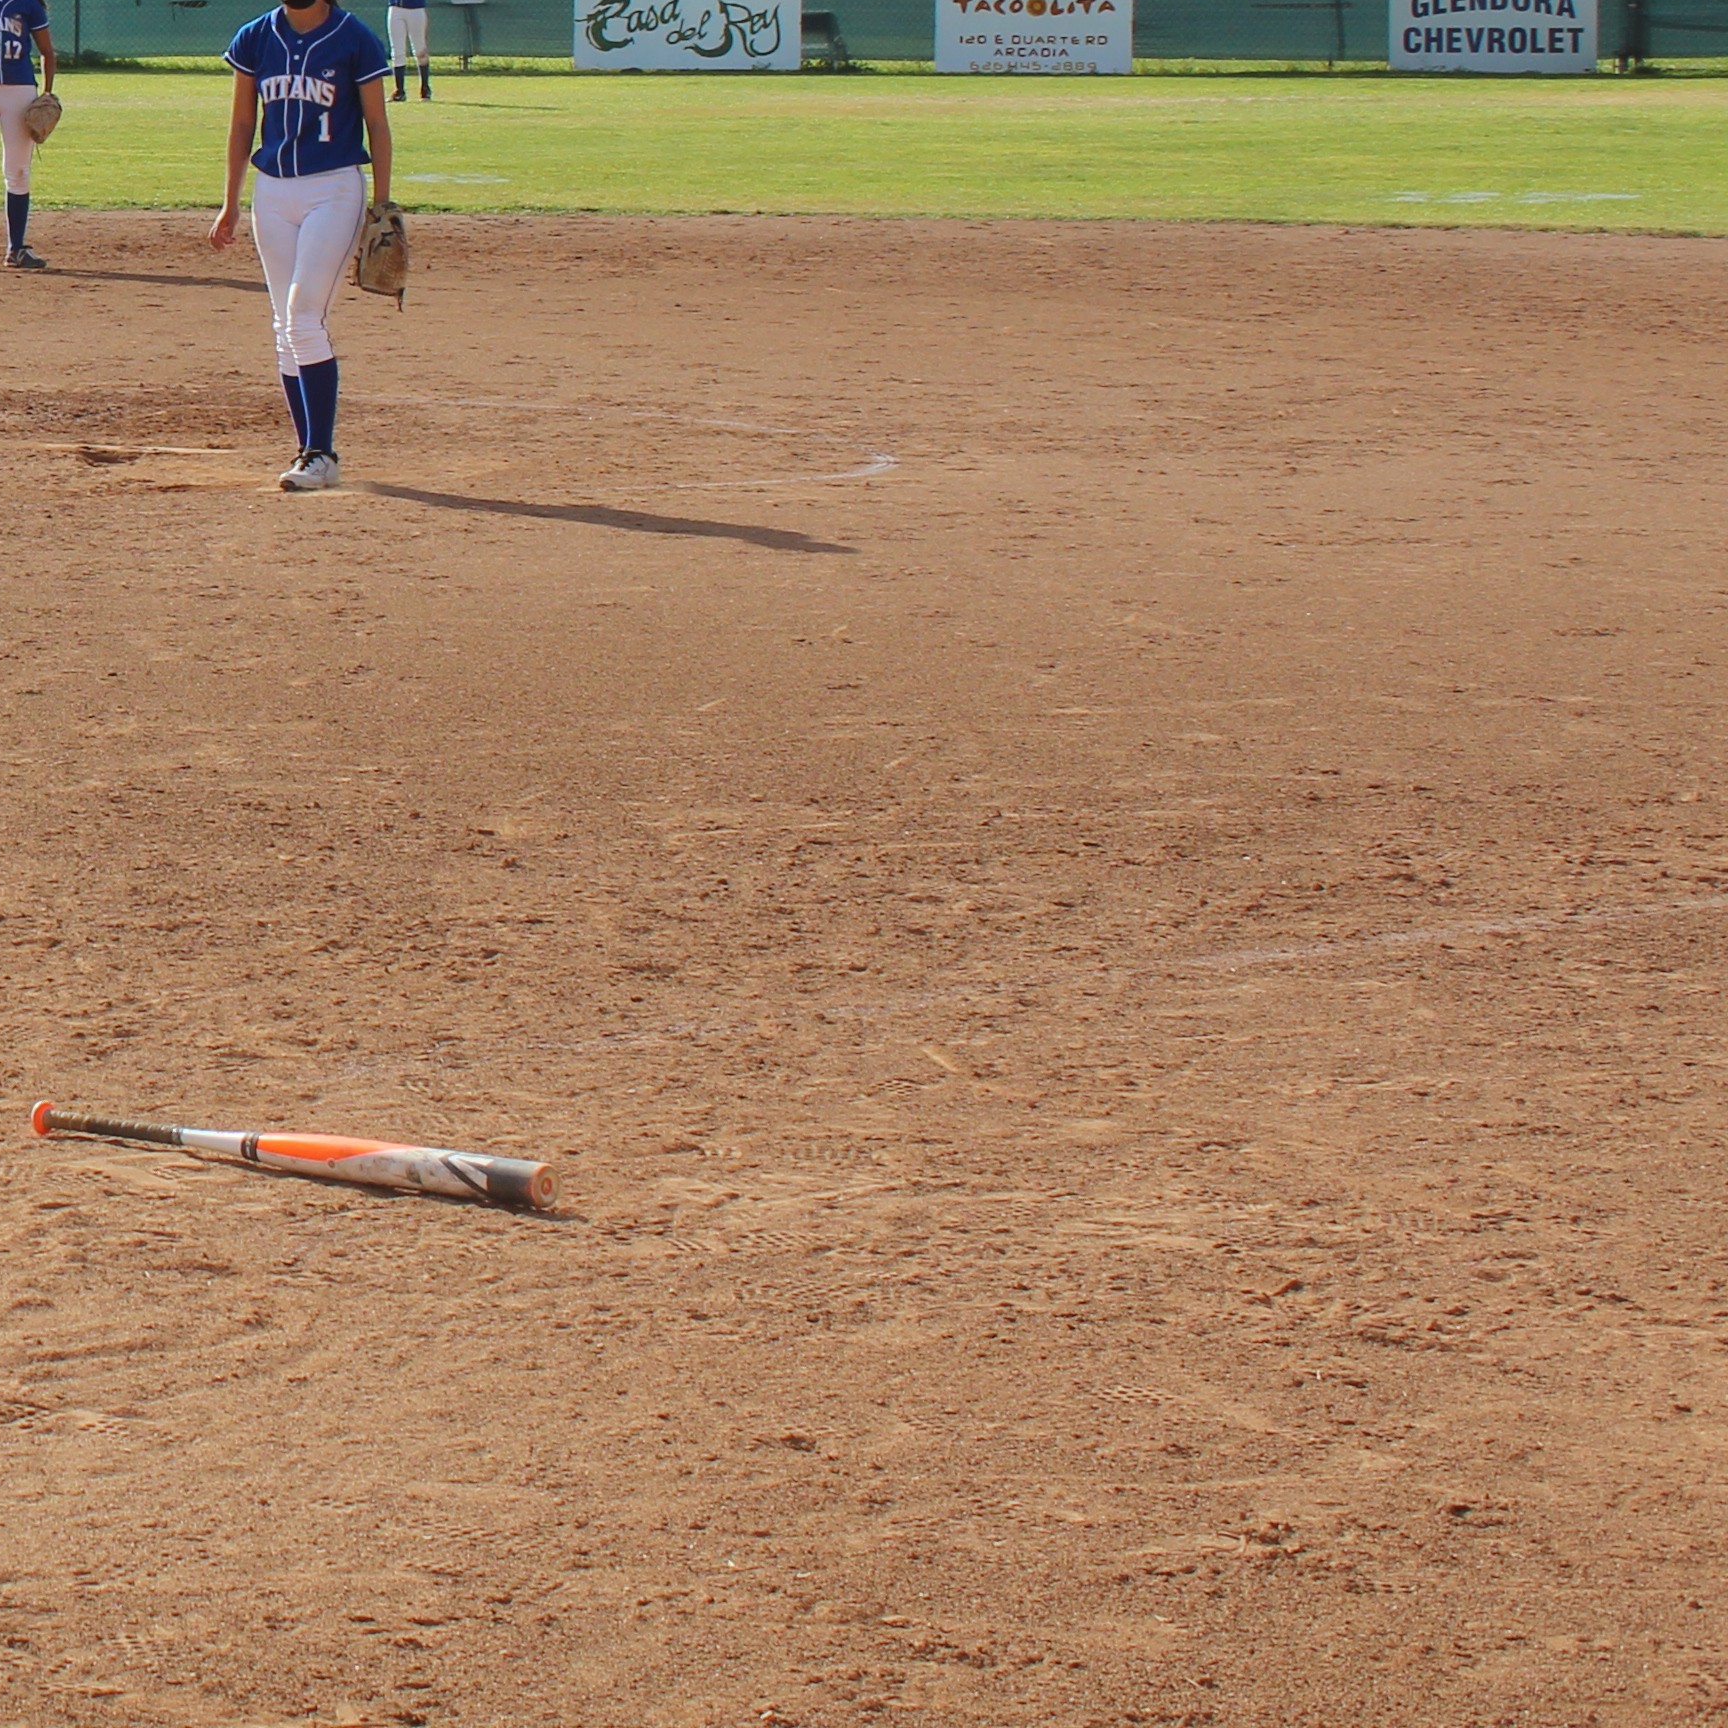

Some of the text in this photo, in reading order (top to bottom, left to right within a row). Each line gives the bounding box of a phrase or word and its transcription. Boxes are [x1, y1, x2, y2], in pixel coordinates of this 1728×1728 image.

[666, 10, 711, 44] del
[684, 0, 781, 57] Rey
[959, 35, 1108, 45] 120 E DUARTE RD
[1403, 27, 1584, 53] CHEVROLET
[4, 40, 22, 59] 17
[993, 48, 1069, 57] ARCADIA
[260, 74, 336, 108] TITANS
[318, 111, 331, 142] 1
